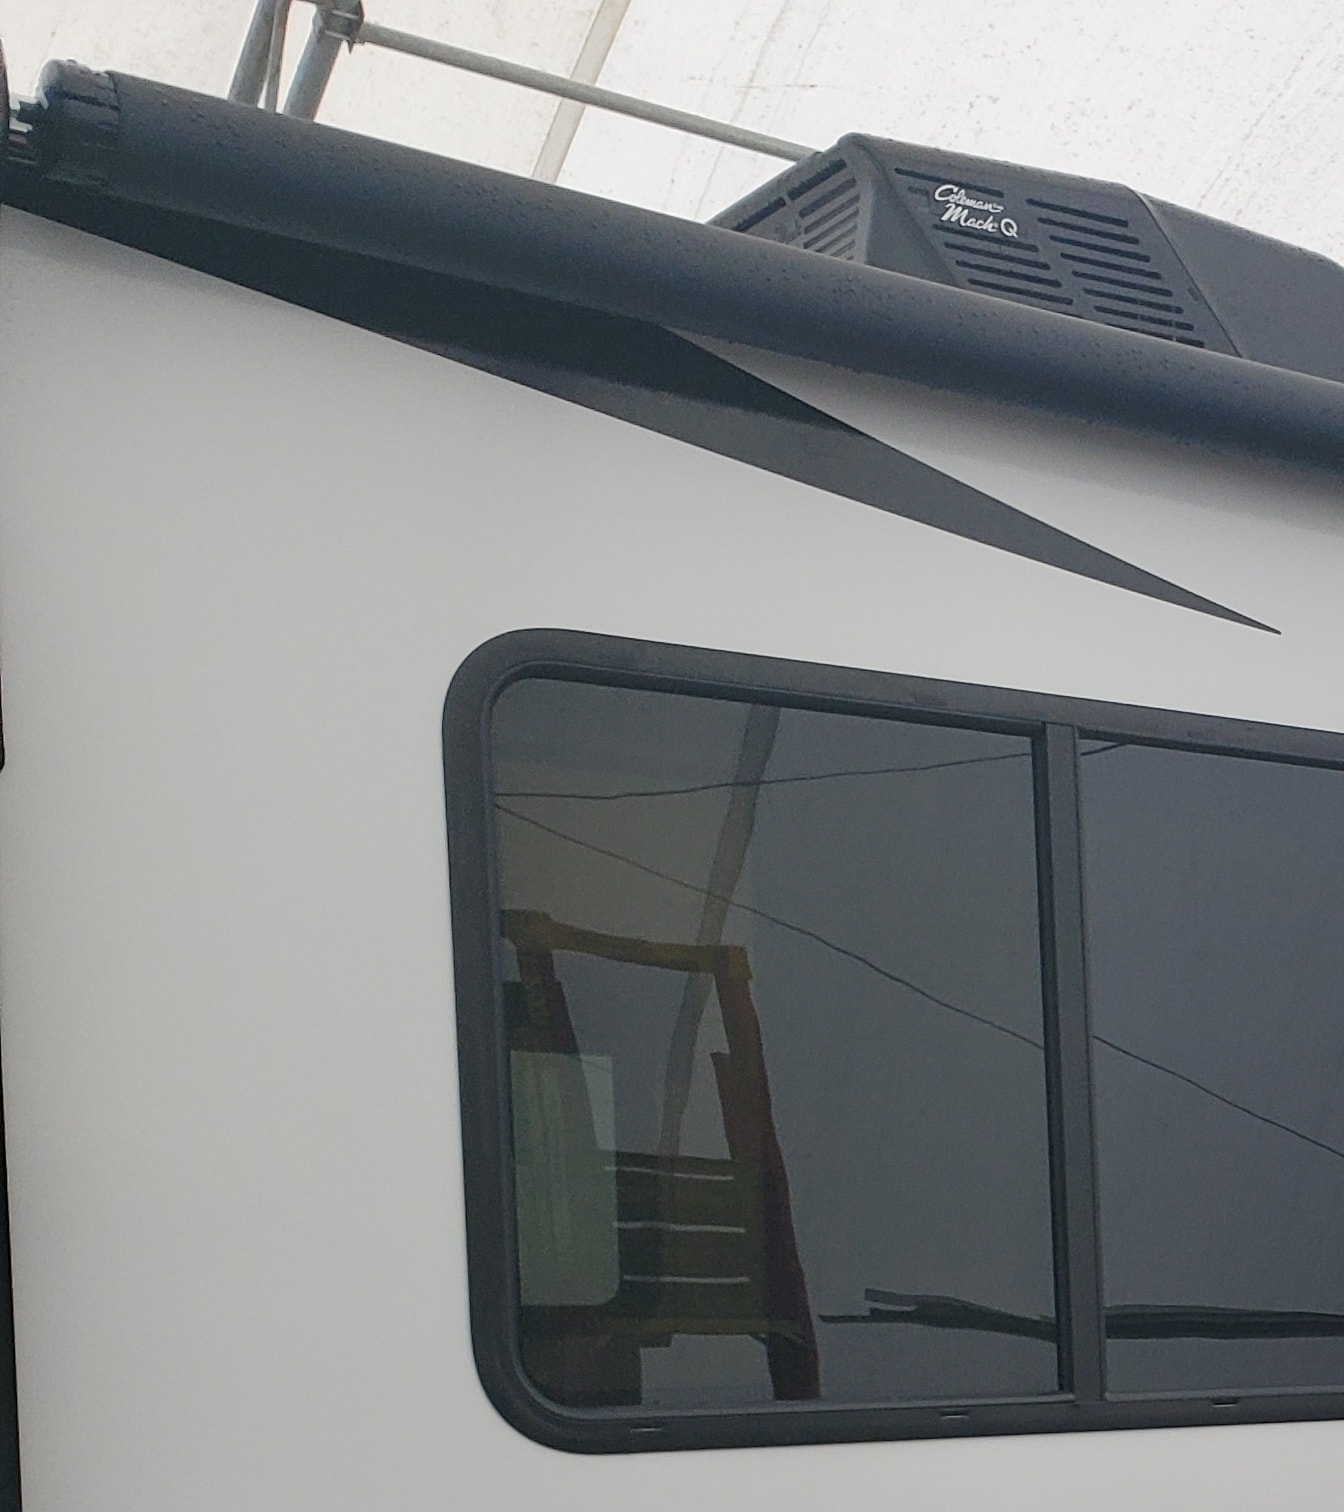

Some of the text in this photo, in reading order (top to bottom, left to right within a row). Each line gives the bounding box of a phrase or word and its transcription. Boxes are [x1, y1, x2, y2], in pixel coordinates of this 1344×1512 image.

[934, 184, 1004, 213] Coleman
[940, 203, 1018, 238] Mach Q
